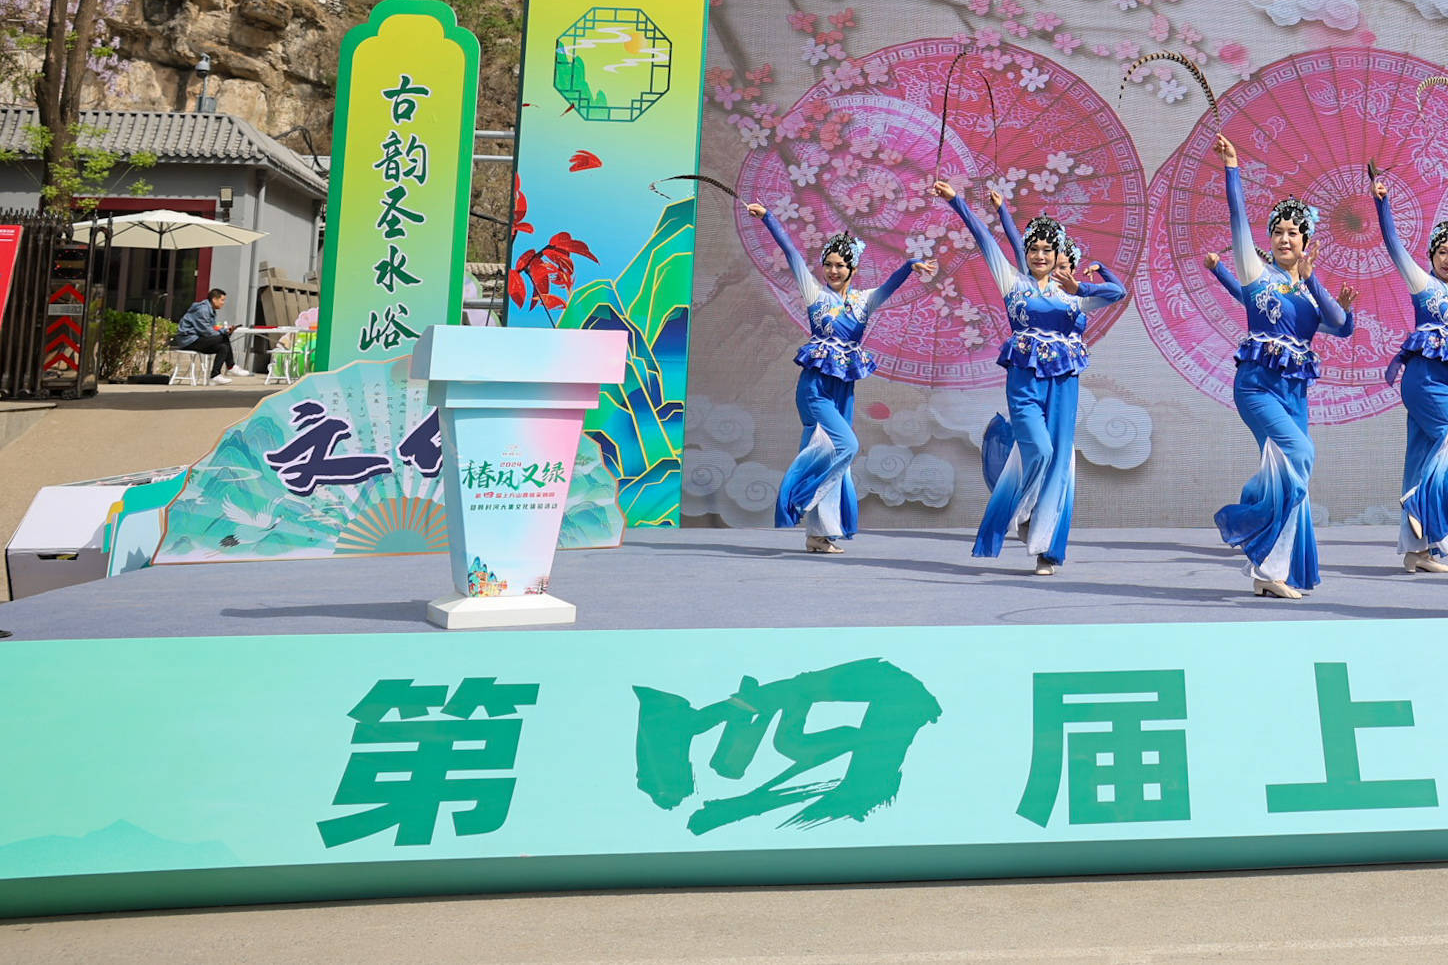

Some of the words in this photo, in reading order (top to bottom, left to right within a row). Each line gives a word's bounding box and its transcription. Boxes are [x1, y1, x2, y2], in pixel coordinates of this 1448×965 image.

[360, 75, 431, 351] 古韵圣水峪
[461, 460, 566, 490] 椿风又绿
